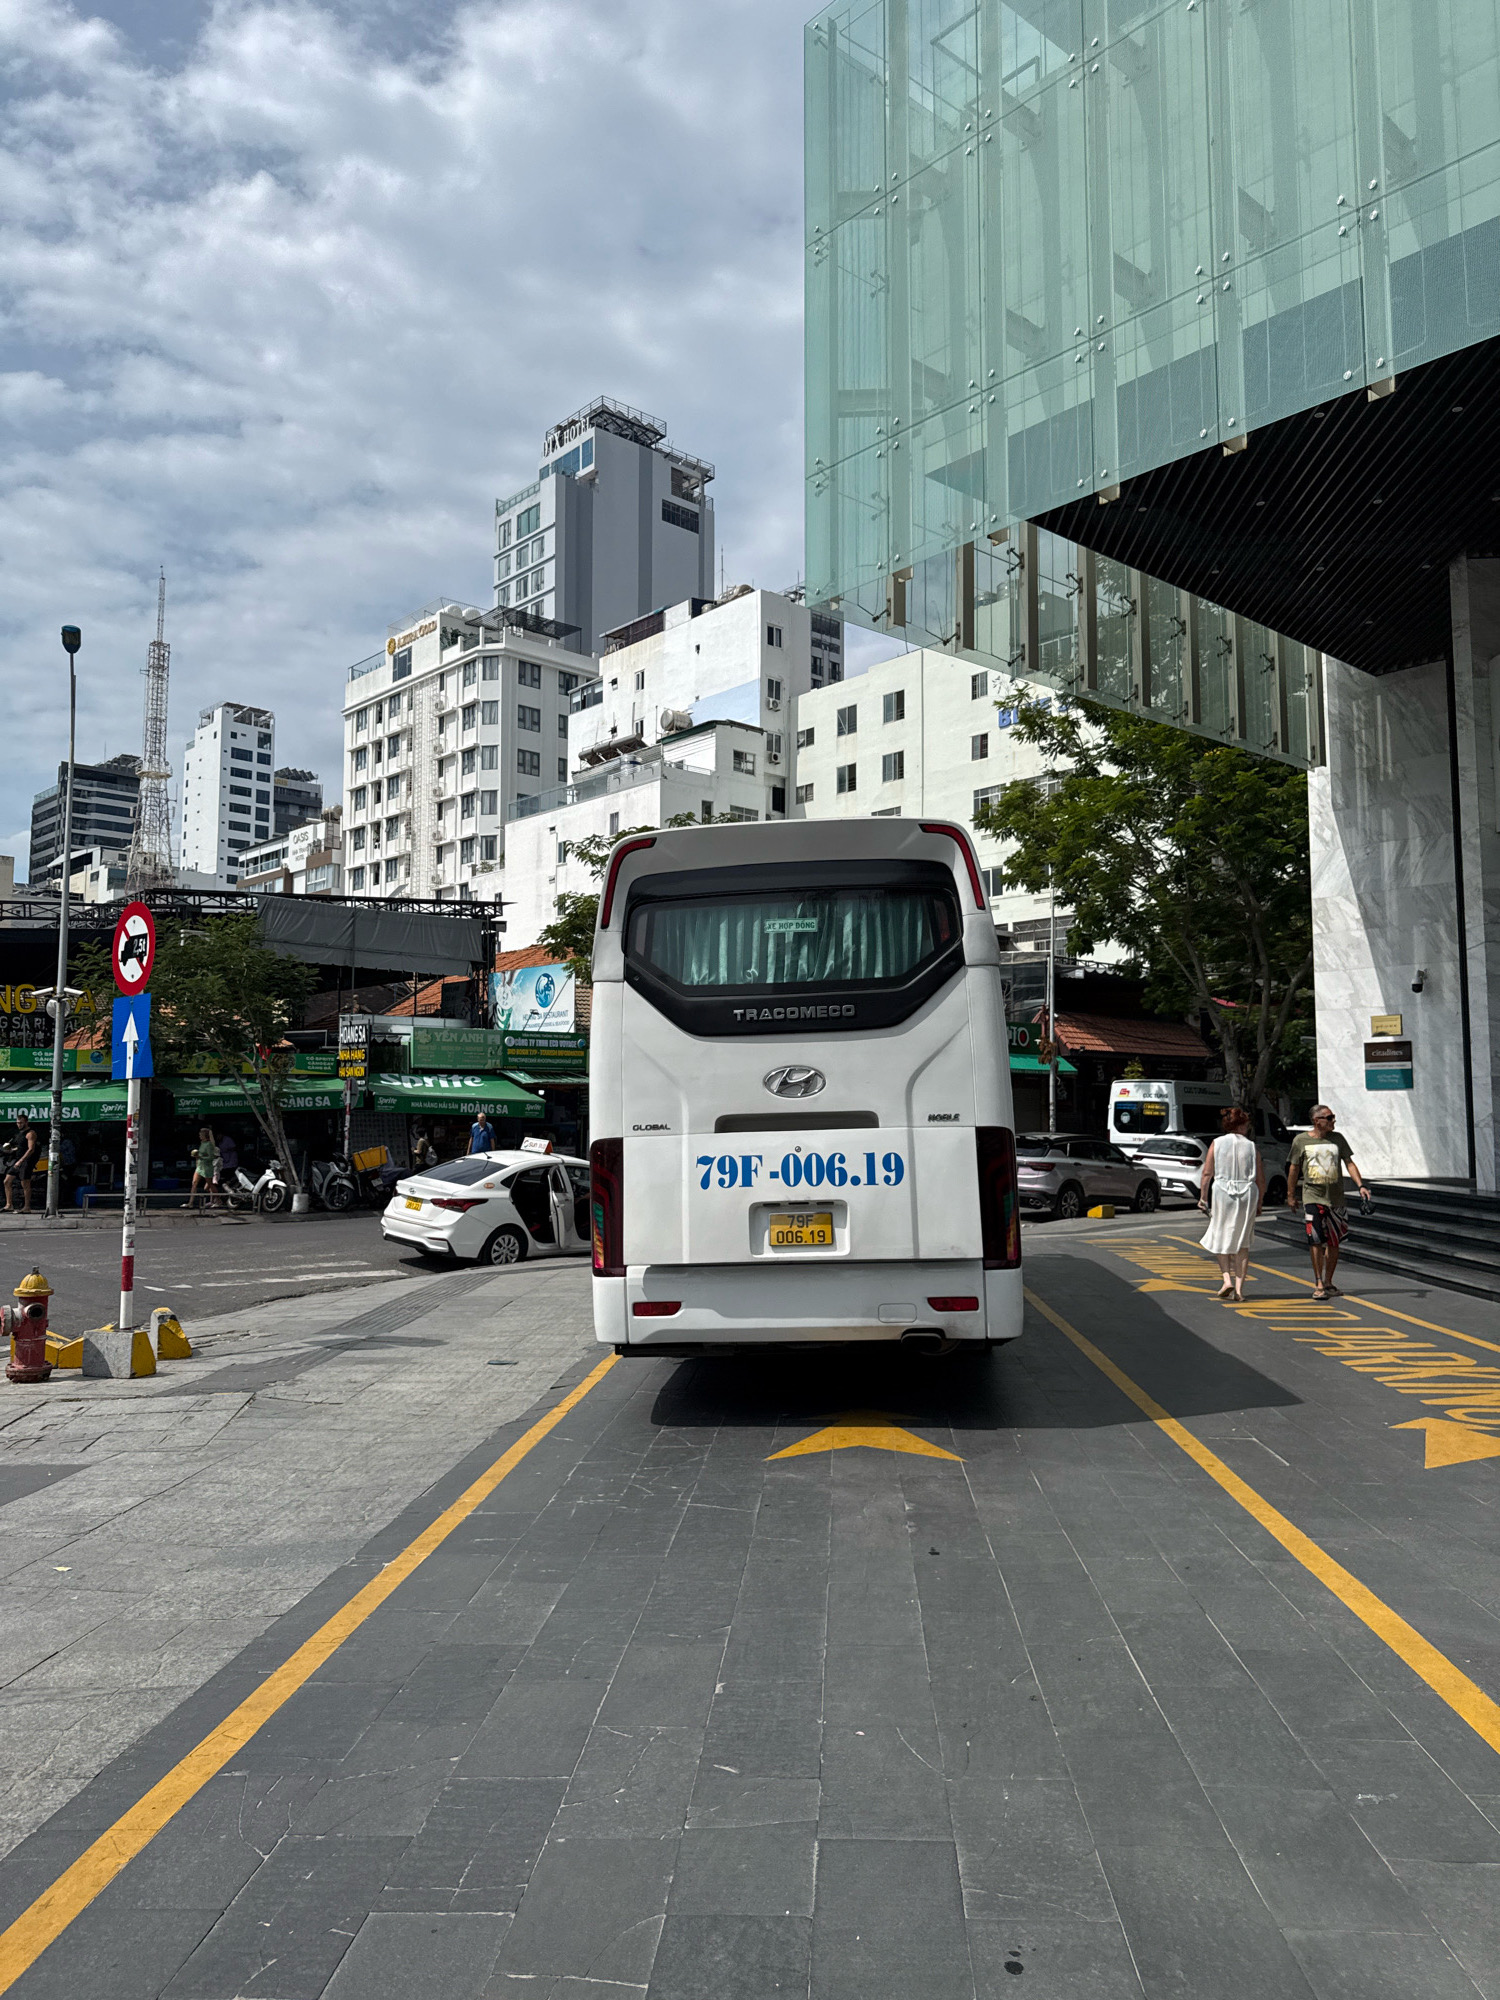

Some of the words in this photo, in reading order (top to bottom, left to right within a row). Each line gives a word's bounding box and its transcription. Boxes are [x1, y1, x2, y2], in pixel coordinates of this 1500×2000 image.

[563, 416, 591, 444] HOTEL
[767, 922, 777, 930] XE
[733, 1004, 856, 1022] TRACOMECO
[358, 1025, 367, 1043] SA
[1371, 1048, 1404, 1057] citadines
[380, 1073, 485, 1089] Sprite
[178, 1098, 202, 1108] Sprite
[314, 1095, 331, 1107] SA
[377, 1096, 398, 1105] Sprite
[100, 1103, 126, 1113] Sprite
[460, 1101, 495, 1114] HOÀNG
[496, 1104, 509, 1115] SA
[525, 1103, 542, 1112] Sprite
[632, 1123, 671, 1131] GLOBAL
[787, 1214, 815, 1229] 79F
[776, 1229, 826, 1244] 006.19
